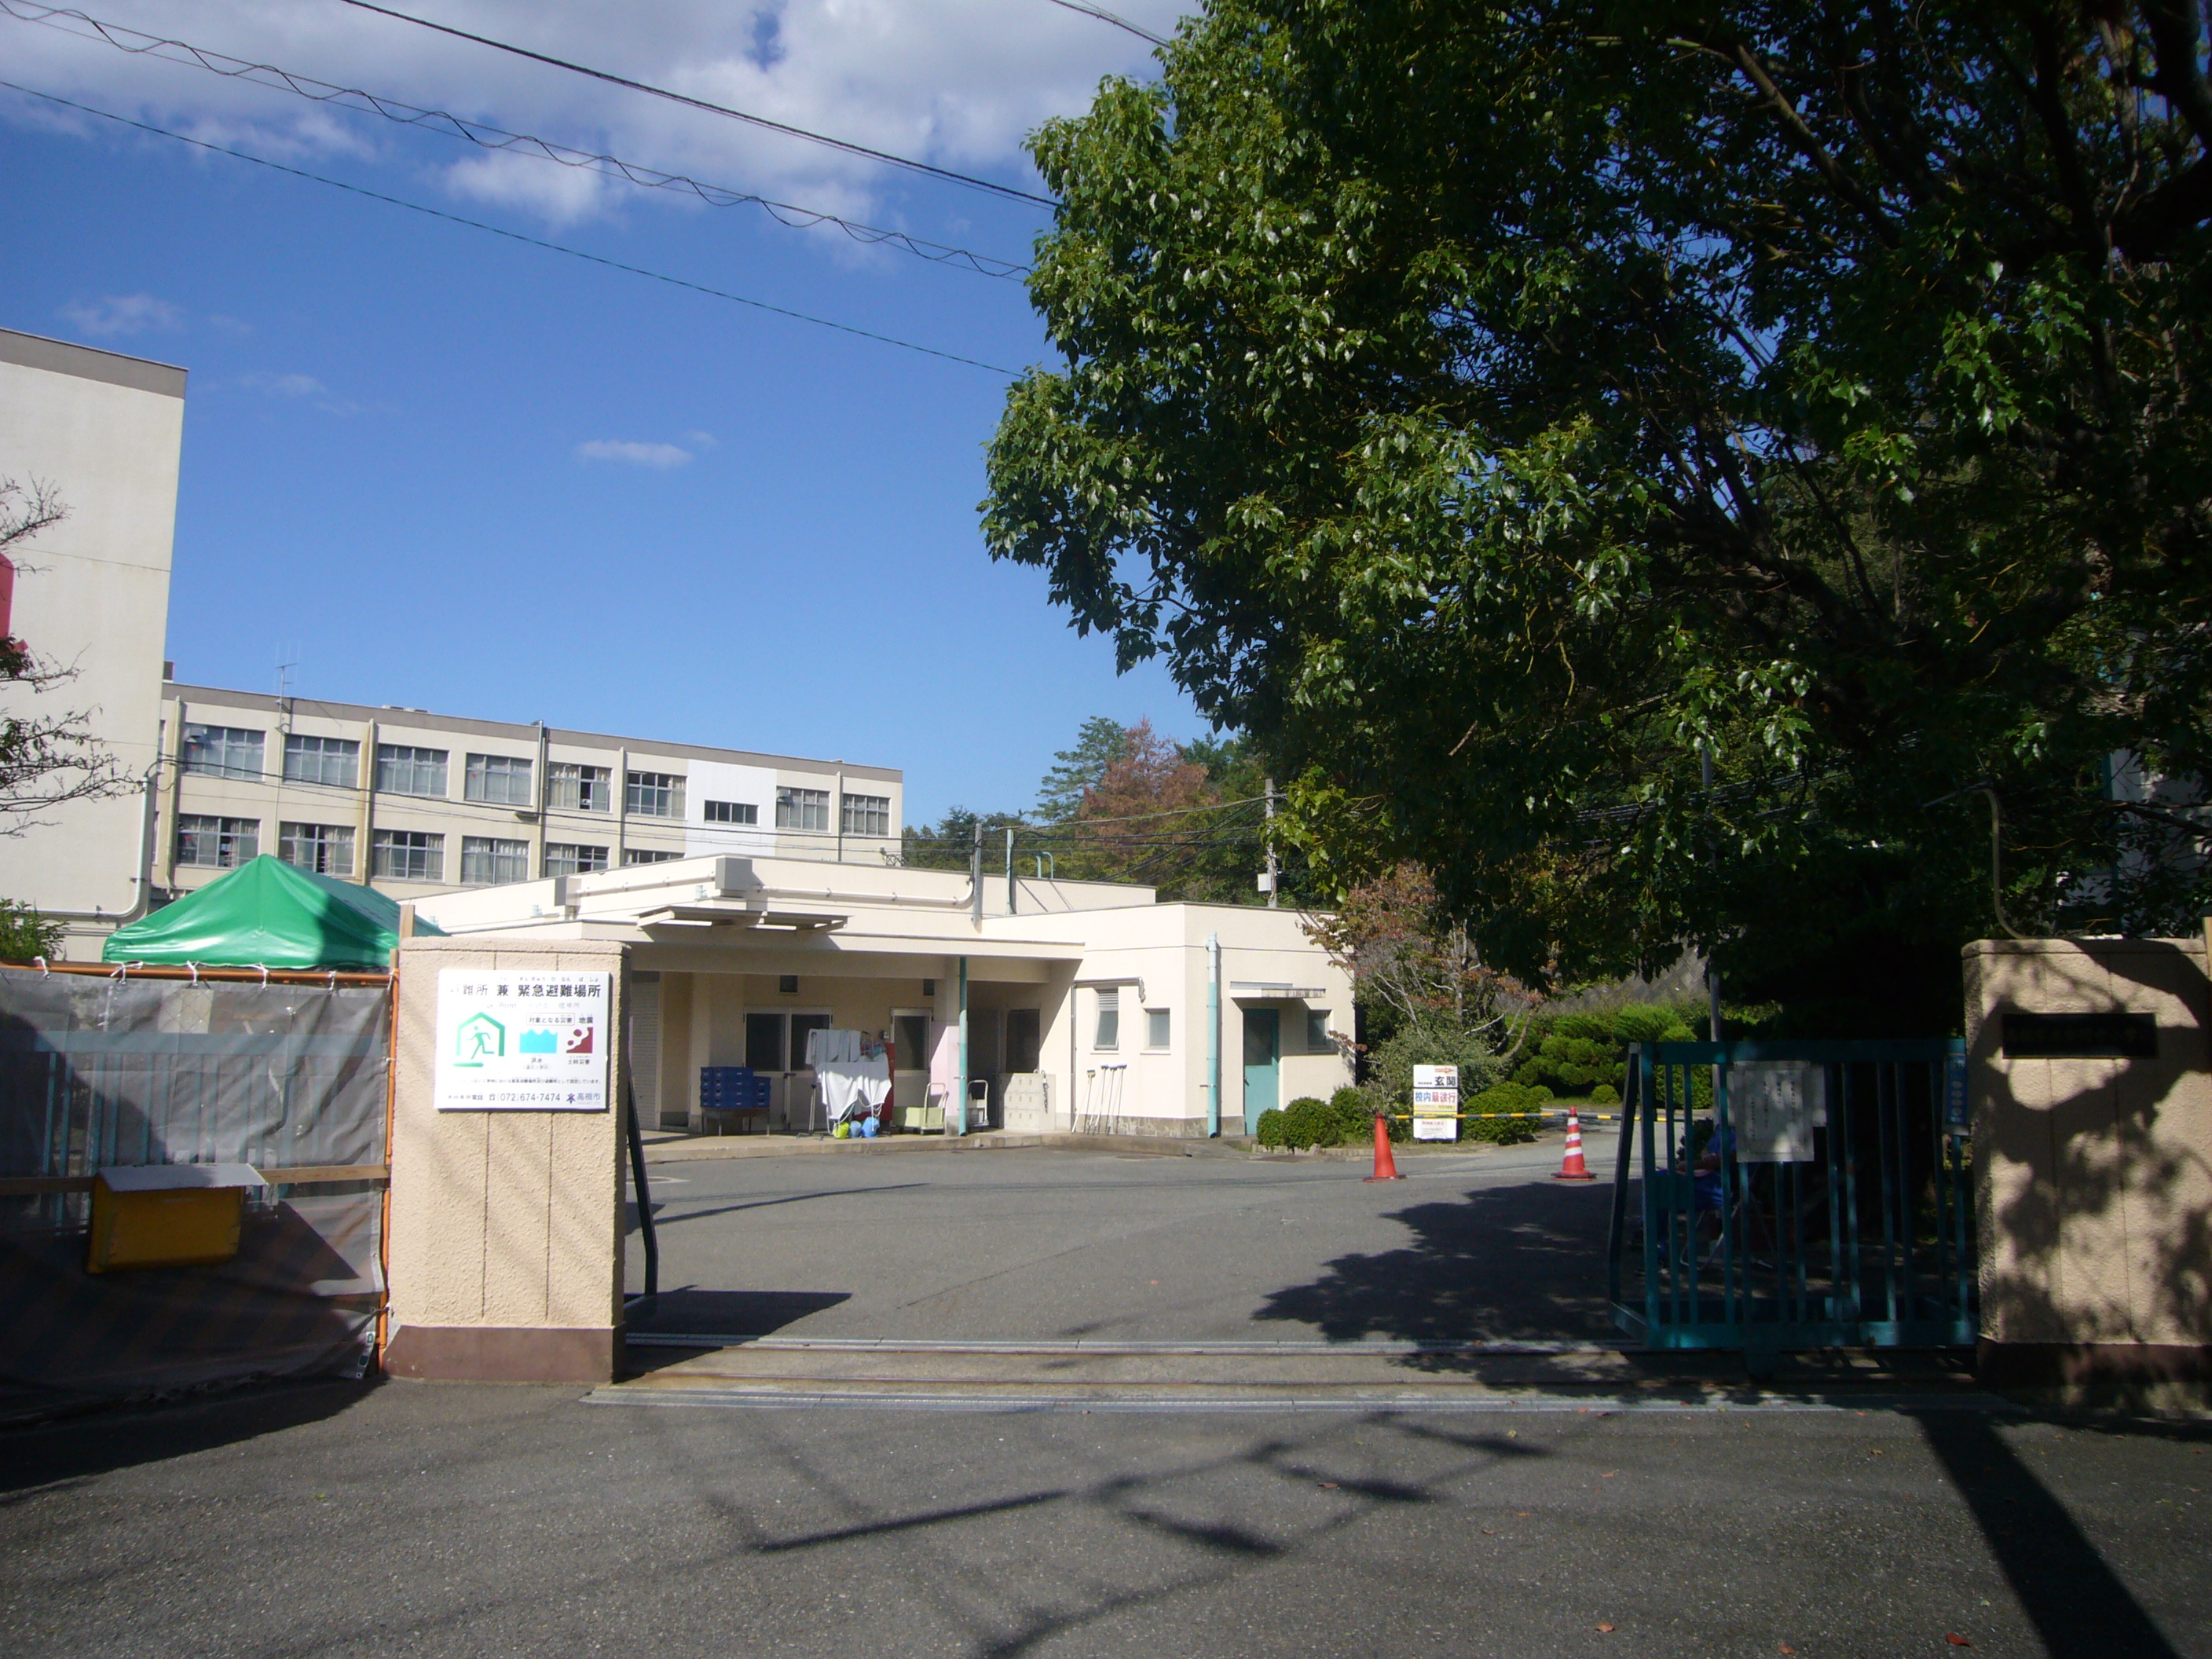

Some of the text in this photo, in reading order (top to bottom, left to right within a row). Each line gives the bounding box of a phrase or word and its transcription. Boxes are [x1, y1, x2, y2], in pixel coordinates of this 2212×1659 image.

[449, 983, 602, 998] 難所 兼 緊急避難場所
[1434, 1075, 1456, 1086] 玄関
